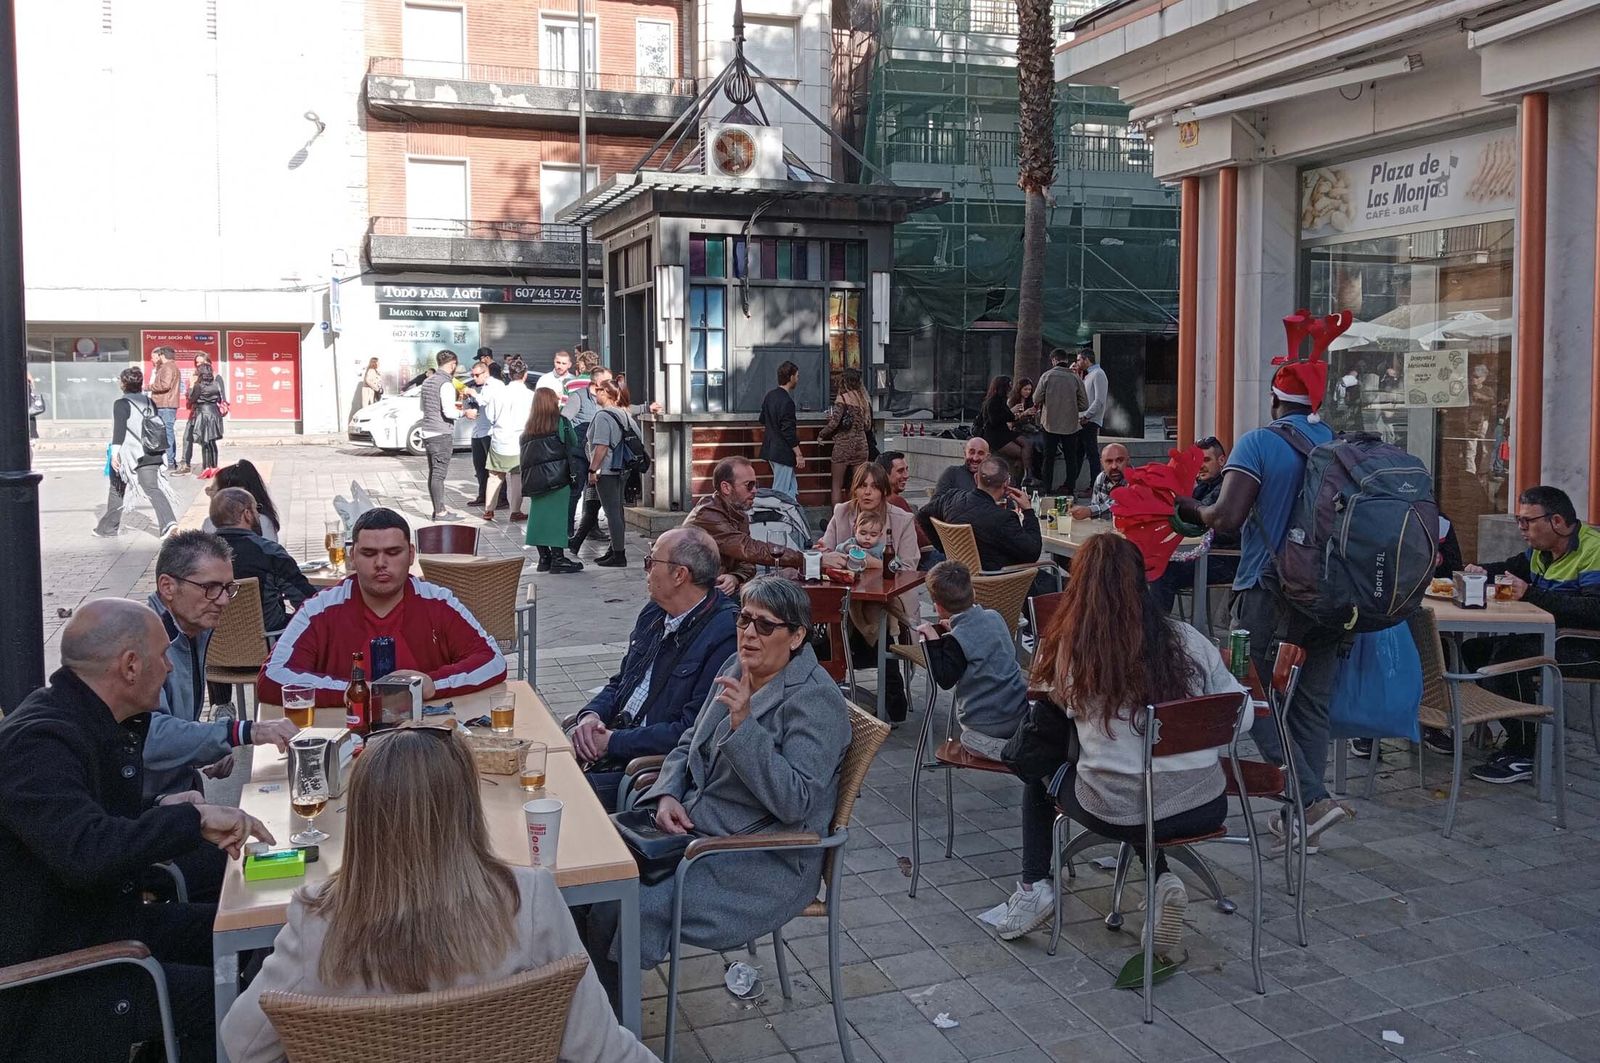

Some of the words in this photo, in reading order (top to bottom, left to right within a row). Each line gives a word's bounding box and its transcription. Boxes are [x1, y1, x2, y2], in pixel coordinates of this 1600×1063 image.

[1370, 161, 1414, 185] Plaza
[1419, 152, 1440, 176] de
[1366, 189, 1389, 209] Las
[1392, 178, 1448, 211] Monjas
[1365, 206, 1391, 220] CAFÉ
[1398, 204, 1420, 216] BAR
[382, 285, 418, 298] TODO
[420, 288, 449, 299] PASA
[515, 287, 536, 298] 607
[537, 288, 551, 298] 44
[553, 288, 567, 299] 57
[569, 289, 582, 299] 75
[389, 307, 424, 317] IMAGINA
[420, 330, 430, 338] 57
[431, 330, 441, 338] 75
[1376, 551, 1386, 567] 75L
[1373, 569, 1384, 598] Sports
